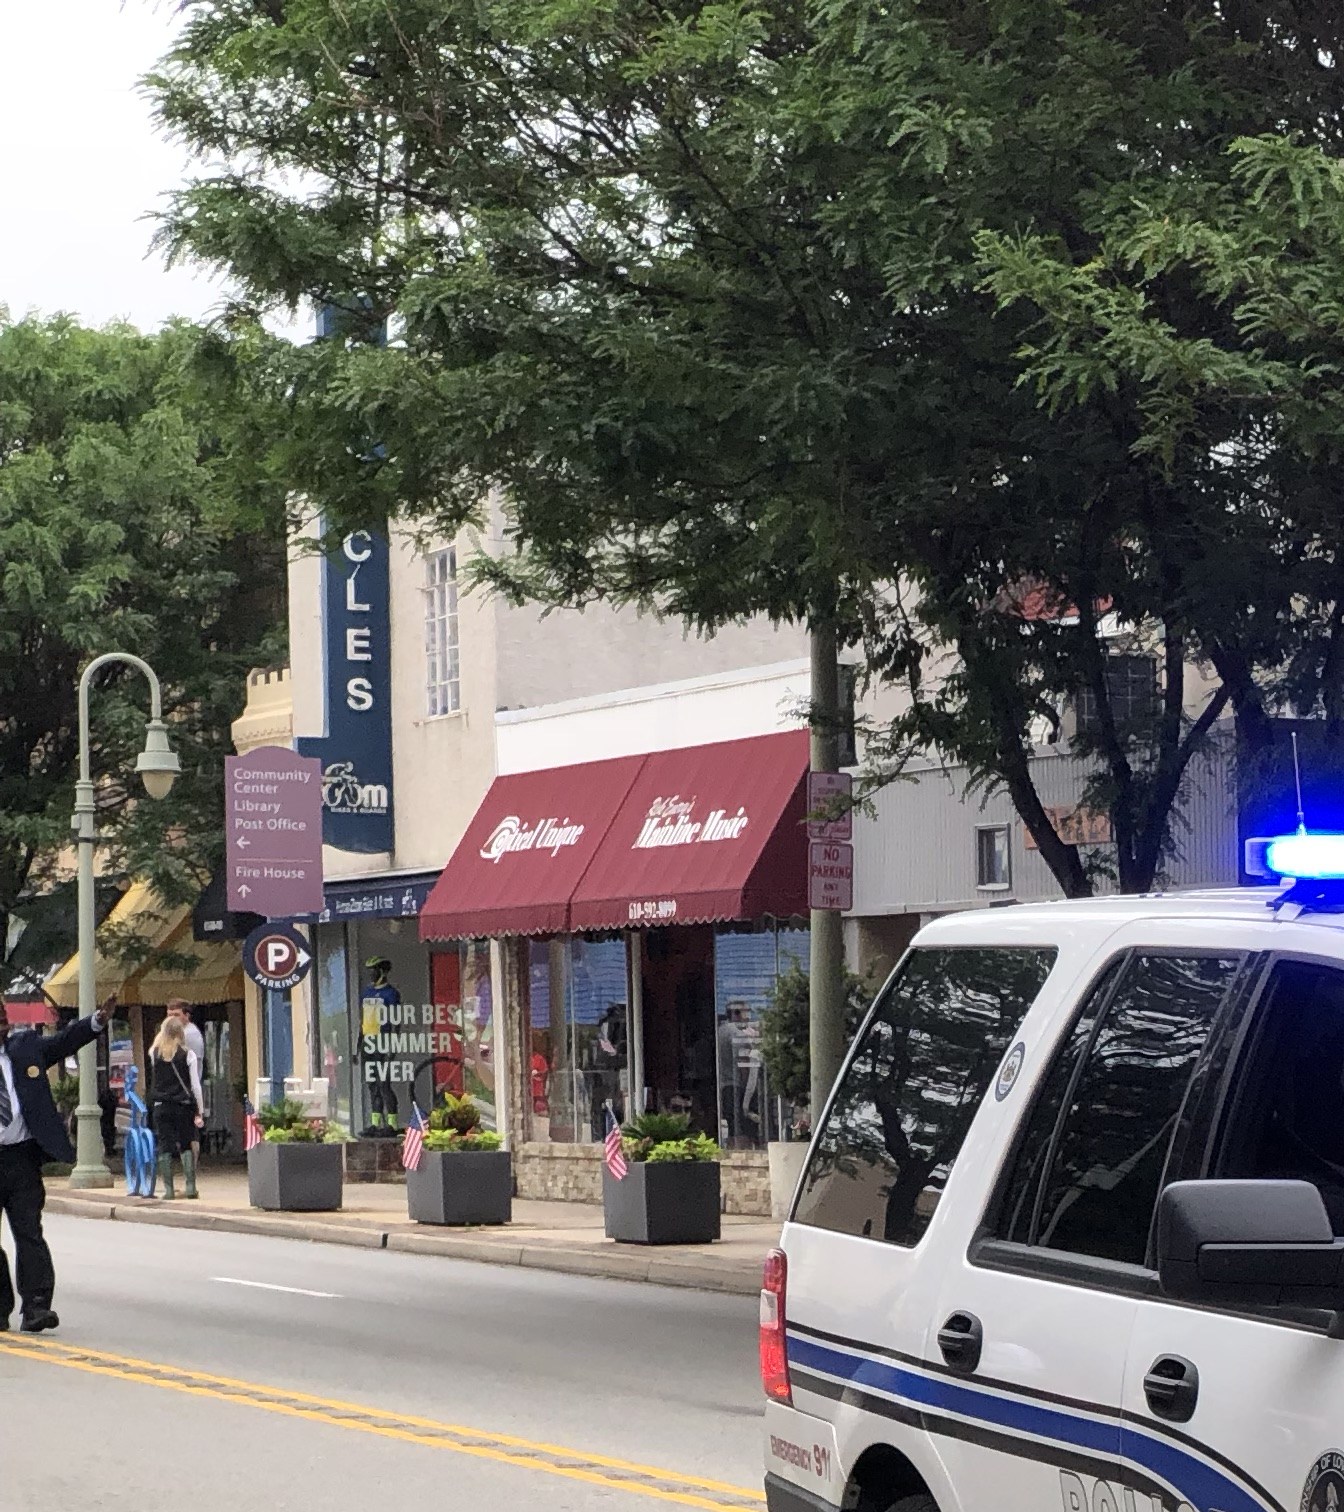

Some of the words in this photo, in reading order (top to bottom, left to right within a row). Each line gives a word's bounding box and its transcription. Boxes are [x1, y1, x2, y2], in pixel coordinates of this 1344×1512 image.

[234, 768, 311, 784] Community
[234, 781, 278, 794] Center
[234, 799, 281, 814] Library
[235, 818, 263, 830] Post
[267, 818, 306, 831] Office
[696, 807, 748, 842] Music
[823, 848, 840, 862] NO
[236, 866, 260, 878] Fire
[264, 866, 305, 880] House
[812, 865, 850, 880] PARKING
[267, 943, 291, 972] P
[254, 973, 300, 989] PARKING
[364, 1032, 453, 1054] SUMMER
[365, 1061, 414, 1082] EVER
[1321, 1455, 1331, 1470] OF
